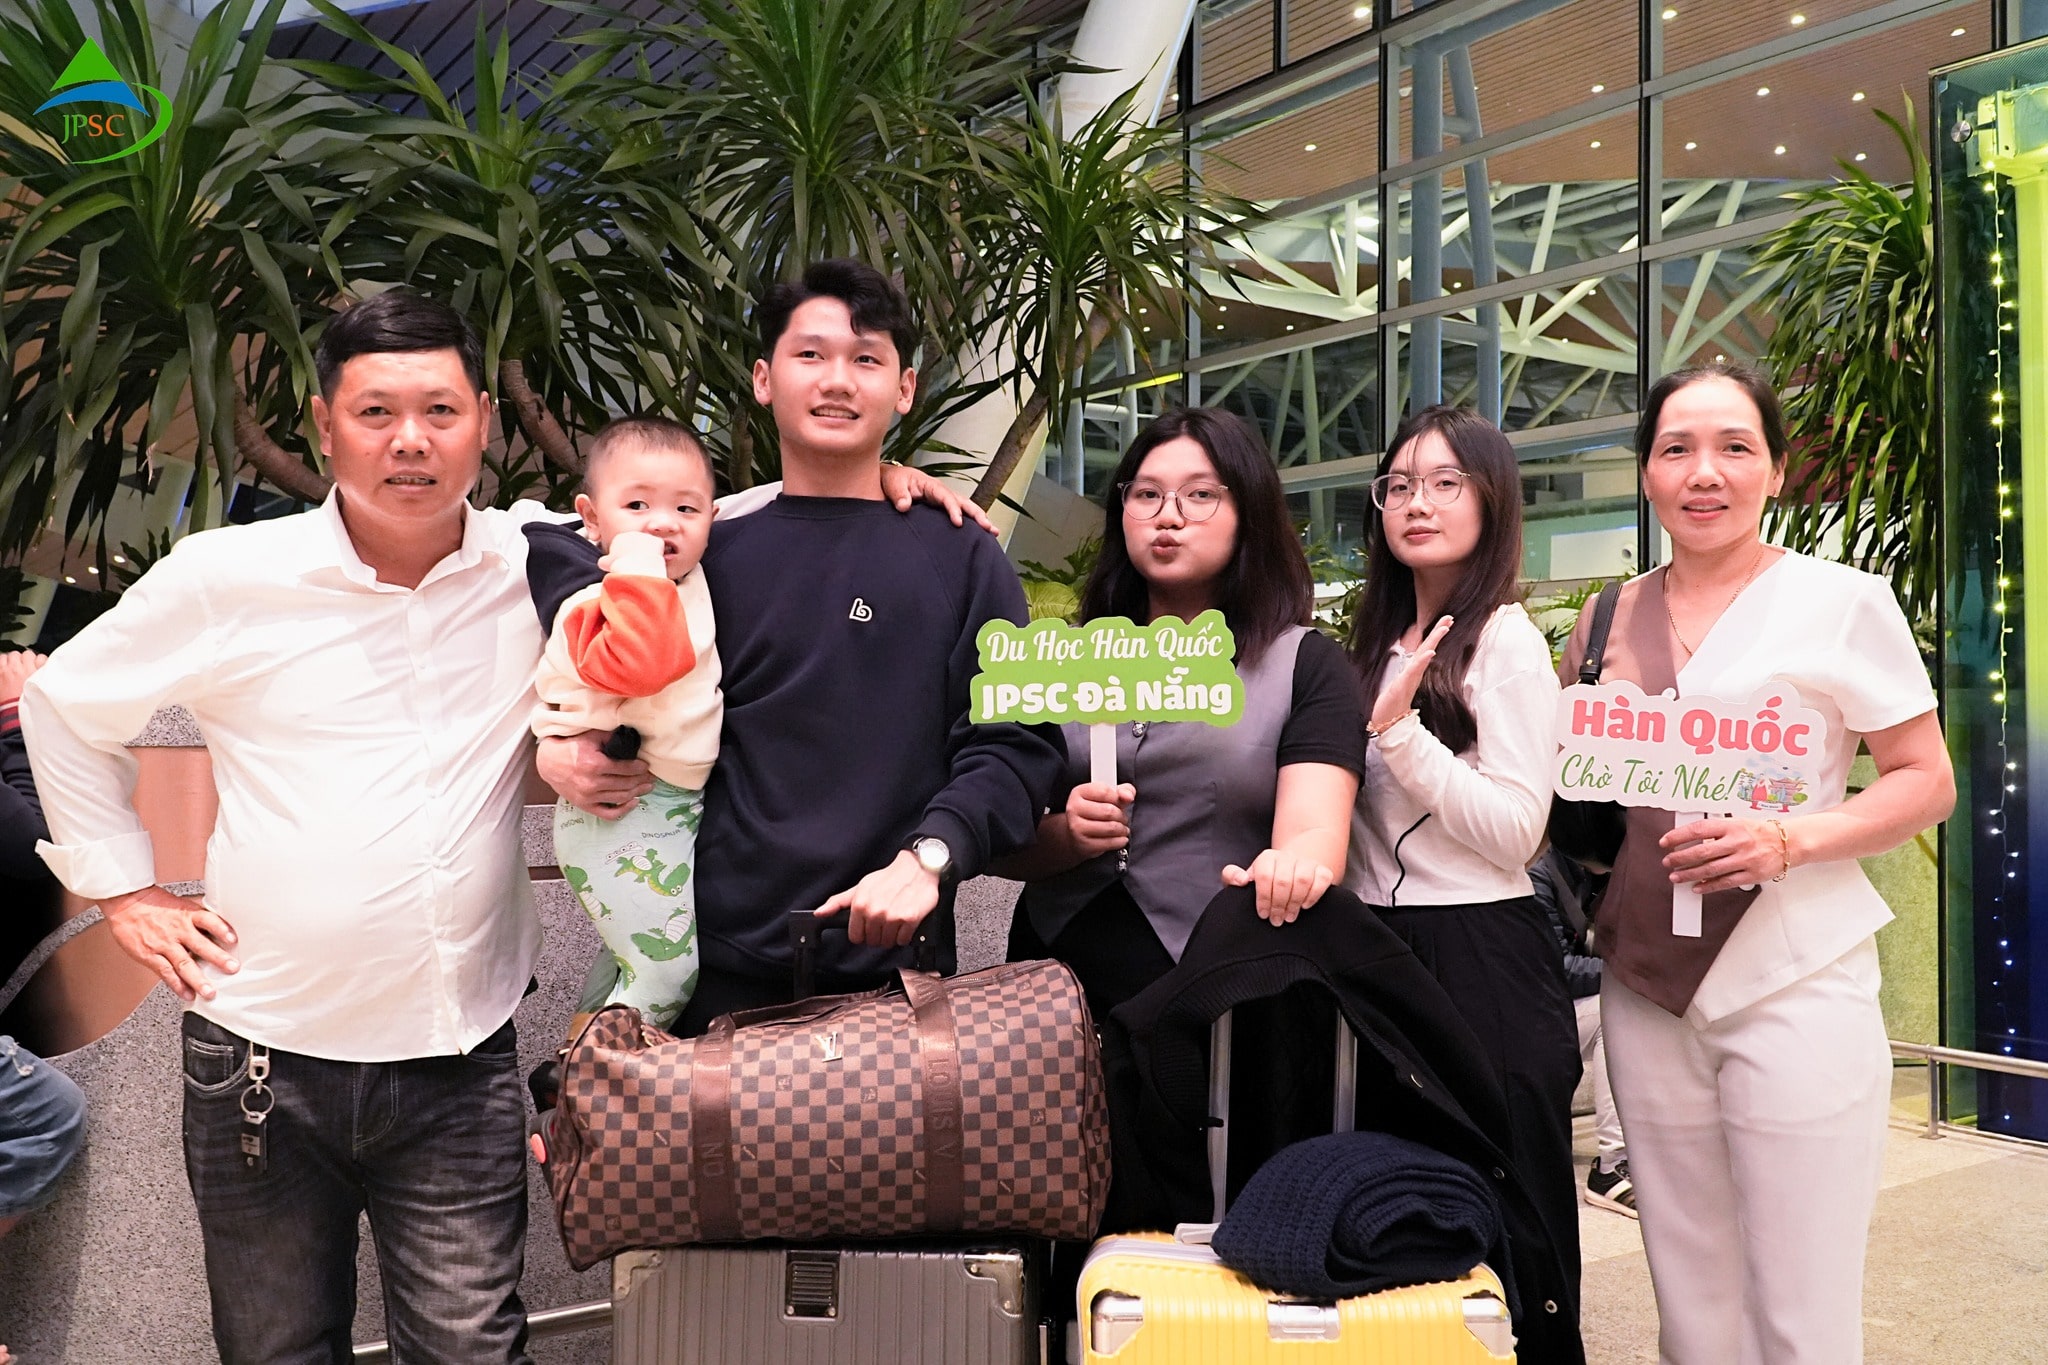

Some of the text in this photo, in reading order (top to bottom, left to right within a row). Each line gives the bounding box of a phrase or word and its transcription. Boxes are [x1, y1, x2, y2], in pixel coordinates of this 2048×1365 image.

[986, 621, 1223, 666] Du Học Hàn Quốc
[981, 667, 1232, 720] JPSC Đà Nẵng
[1571, 695, 1810, 756] Hàn Quốc
[1560, 753, 1742, 802] Chờ Tôi Nhé!
